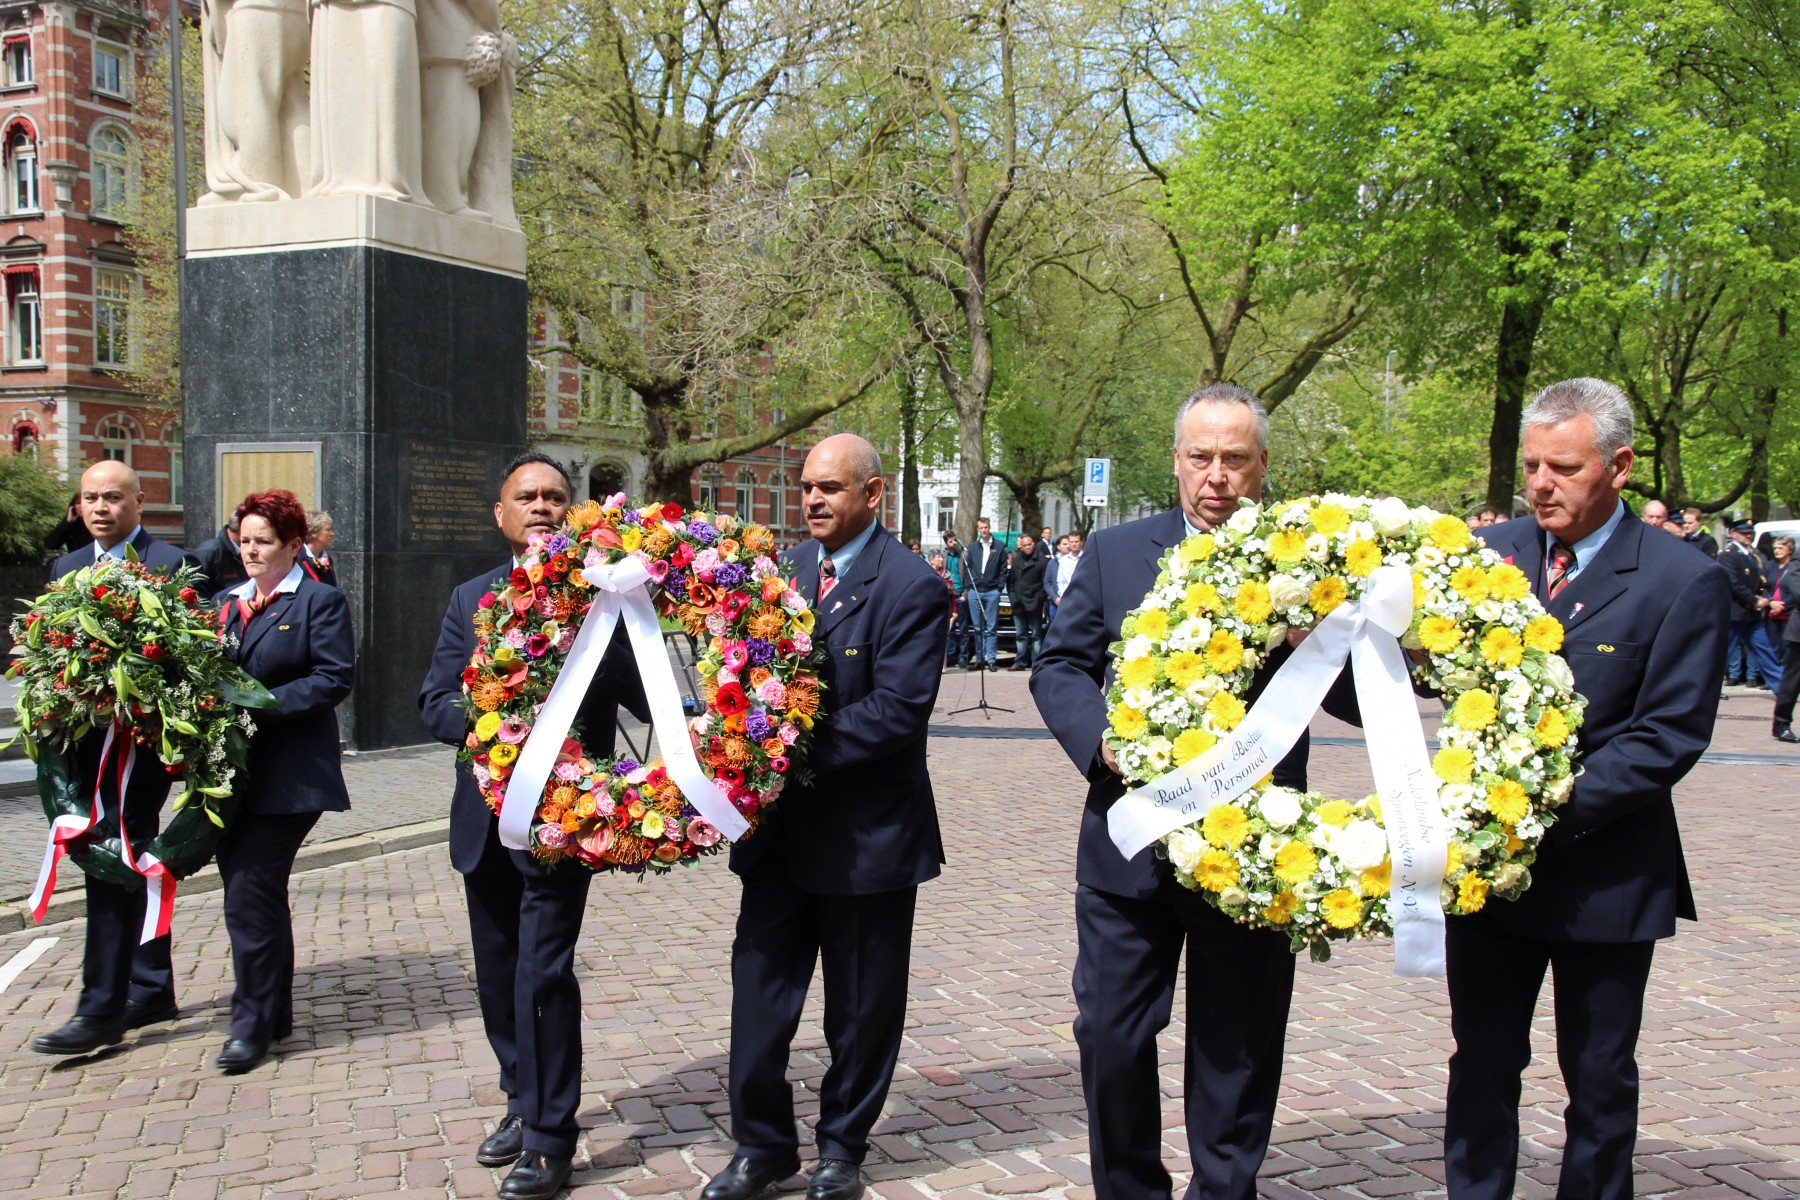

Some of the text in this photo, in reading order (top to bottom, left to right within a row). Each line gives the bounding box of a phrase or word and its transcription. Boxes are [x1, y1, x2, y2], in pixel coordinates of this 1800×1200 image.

[1093, 463, 1102, 475] P
[1154, 777, 1193, 808] Raad
[1201, 762, 1227, 783] van
[1181, 747, 1269, 815] en Personeel
[1404, 762, 1433, 843] Nederlandse
[1388, 790, 1415, 868] Spoorwegen
